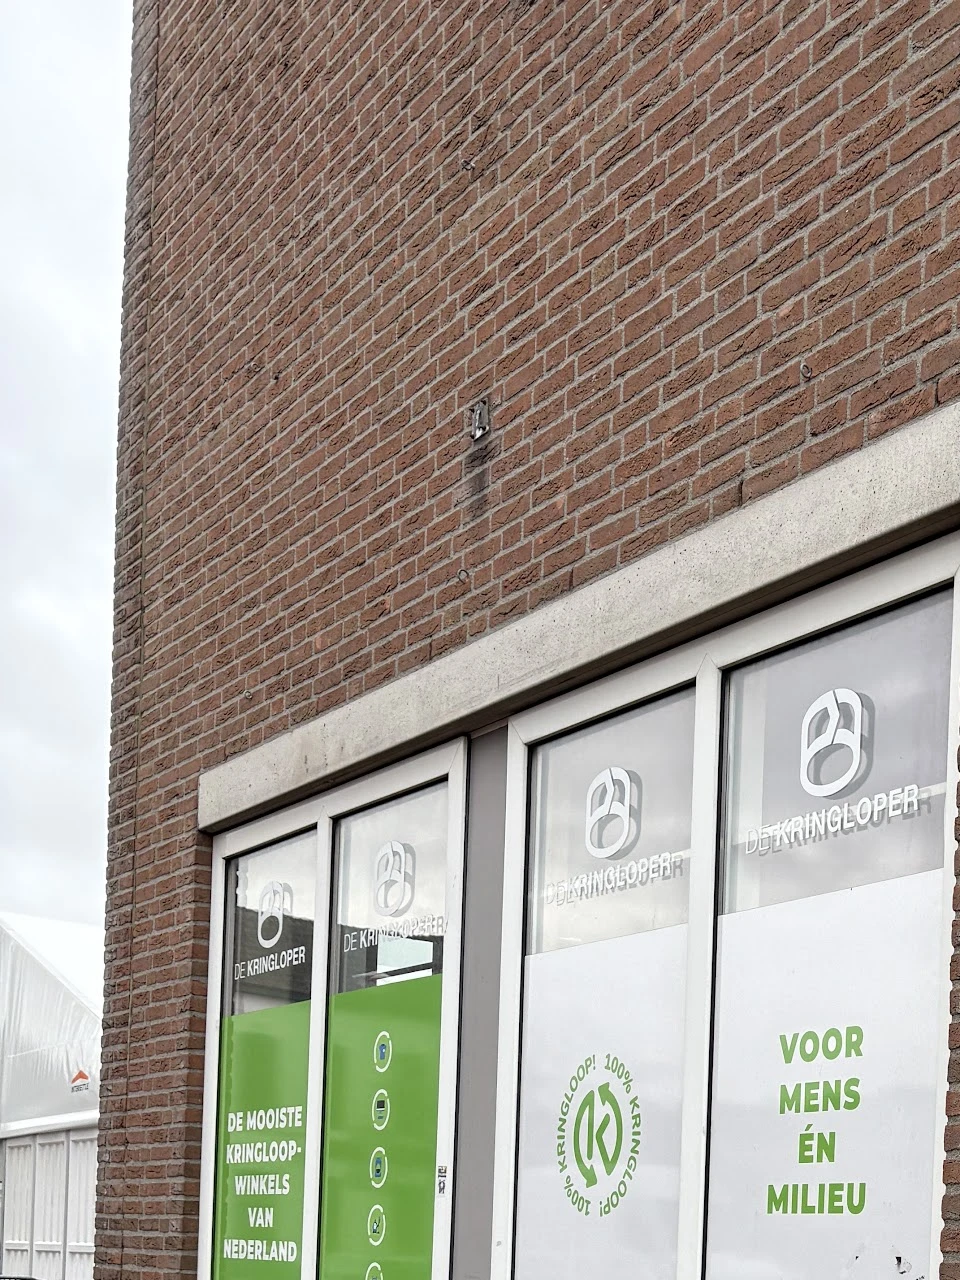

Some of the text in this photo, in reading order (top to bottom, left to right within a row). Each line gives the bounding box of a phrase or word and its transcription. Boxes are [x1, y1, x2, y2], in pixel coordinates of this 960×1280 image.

[775, 783, 919, 847] KRINGLOPER
[568, 851, 671, 899] KRINGLOPER
[343, 931, 358, 953] DE
[234, 946, 306, 981] DE KRINGLOPER
[779, 1025, 864, 1064] VOOR
[604, 1053, 634, 1094] 100%
[779, 1077, 861, 1115] MENS
[227, 1105, 303, 1133] DE MOOISTE
[226, 1139, 302, 1164] KRINGLOOP-
[798, 1123, 836, 1164] ÉN
[234, 1173, 290, 1196] WINKELS
[563, 1175, 592, 1217] 100%
[766, 1182, 867, 1215] MILIEU
[247, 1207, 274, 1228] VAN
[223, 1238, 298, 1262] NEDERLAND
